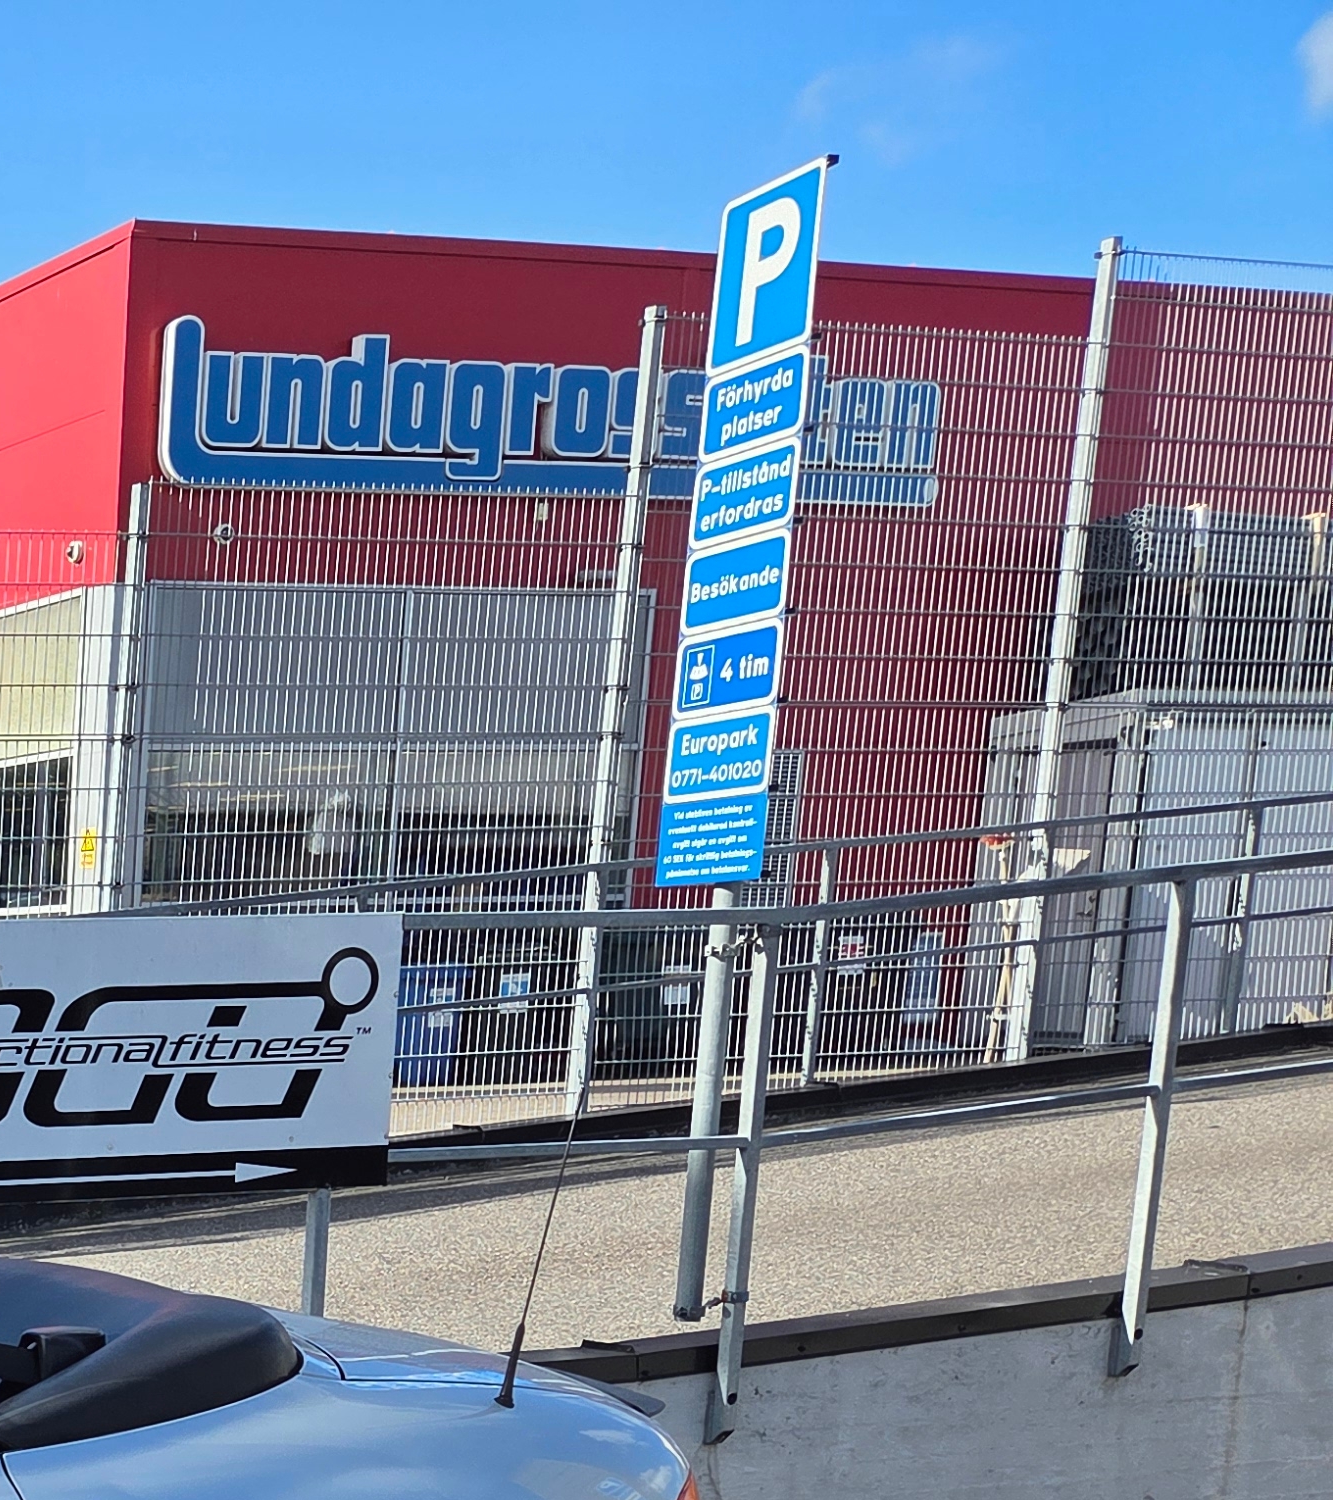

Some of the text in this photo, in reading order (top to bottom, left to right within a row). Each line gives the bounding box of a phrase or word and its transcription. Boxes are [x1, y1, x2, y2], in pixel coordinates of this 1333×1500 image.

[735, 197, 801, 347] P
[716, 367, 794, 412] Förhyrda
[720, 404, 782, 447] platser
[701, 453, 791, 502] P-tillstånd
[699, 492, 784, 532] erfordras
[690, 564, 780, 603] Besökande
[720, 653, 769, 682] 4 tim
[680, 723, 759, 757] Europark
[671, 760, 762, 789] 0771-401020
